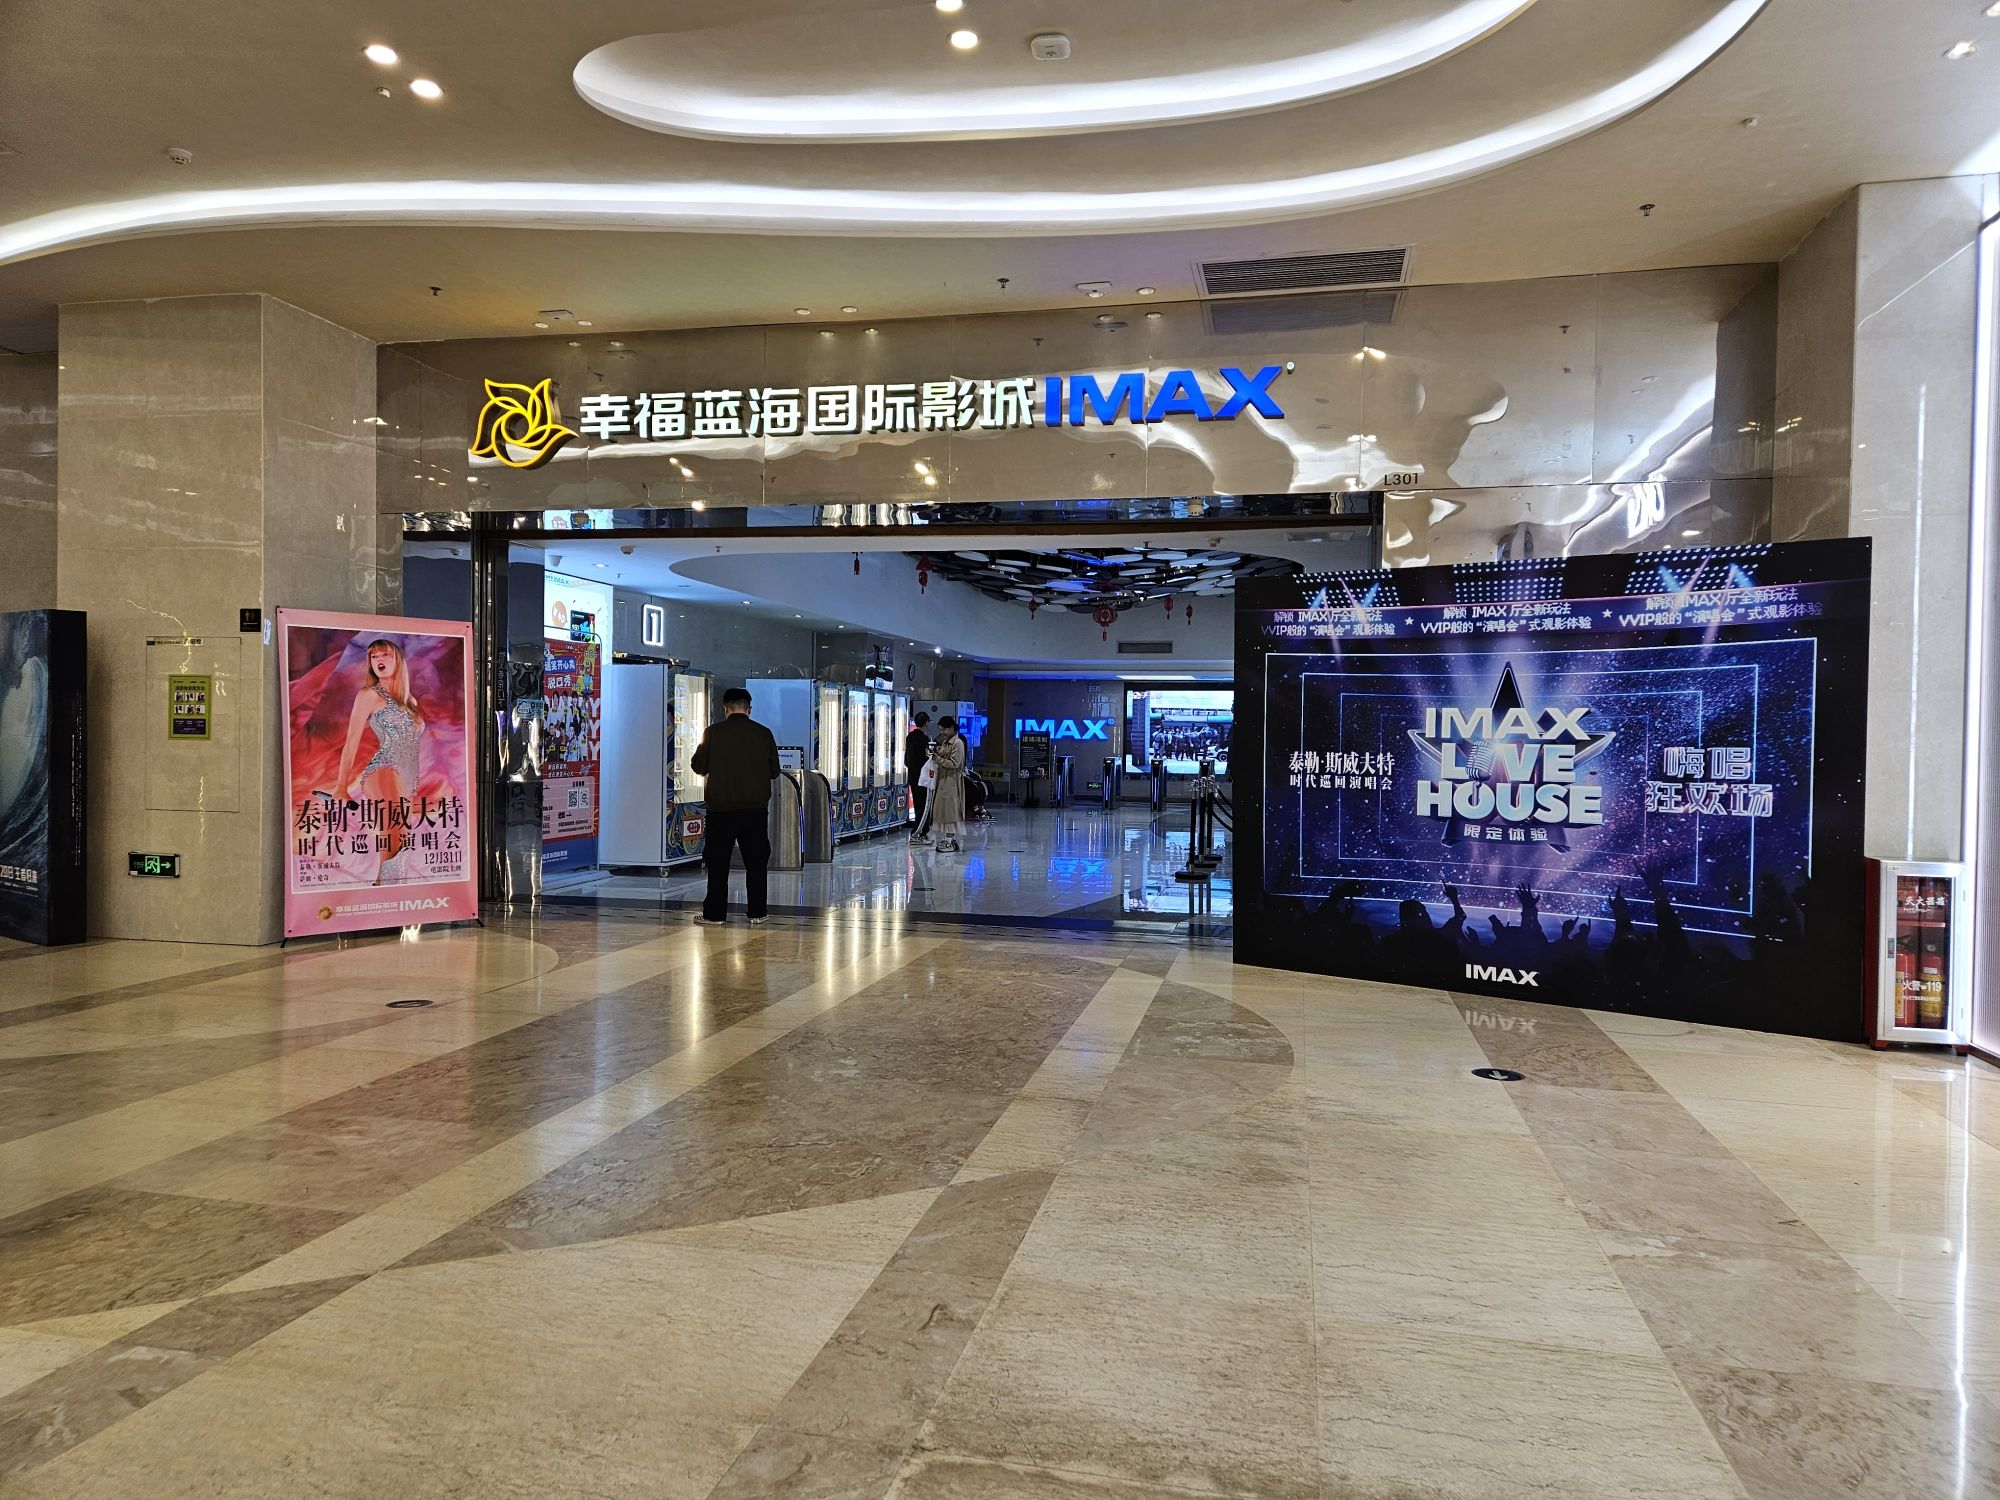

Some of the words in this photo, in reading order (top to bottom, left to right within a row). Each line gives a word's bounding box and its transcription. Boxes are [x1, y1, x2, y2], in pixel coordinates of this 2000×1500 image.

[1044, 366, 1285, 426] IMAX
[578, 377, 1036, 440] 幸福蓝海国际影城
[1383, 472, 1419, 486] L301
[1646, 596, 1674, 610] 解锁
[1680, 593, 1722, 608] IMAX
[1725, 587, 1798, 606] 厅全新玩法
[1273, 611, 1294, 623] 解锁
[1298, 610, 1328, 622] IMAX
[1330, 610, 1382, 623] 厅全新玩法
[1442, 606, 1467, 620] 解锁
[1471, 605, 1507, 618] IMAX
[1509, 602, 1571, 617] 厅全新玩法
[547, 674, 572, 689] 脱口秀
[1015, 718, 1109, 740] IMAX
[1425, 707, 1591, 740] IMAX
[1288, 750, 1395, 776] 泰勒·斯威夫特
[1663, 746, 1751, 779] 嗨唱
[1289, 774, 1393, 790] 时代巡回演唱会
[1417, 780, 1603, 824] HOUSE
[1645, 781, 1773, 817] 狂欢场
[295, 795, 464, 834] 泰勒·斯威夫特
[1463, 824, 1549, 841] 限定体验
[298, 831, 462, 857] 时代巡回演唱会
[424, 850, 462, 865] 12月31日
[14, 866, 38, 884] 王者归来
[430, 864, 462, 874] 电影院上映
[400, 897, 450, 911] IMAX
[1465, 963, 1539, 987] IMAX
[1901, 980, 1921, 991] 火警
[1926, 981, 1942, 992] 119
